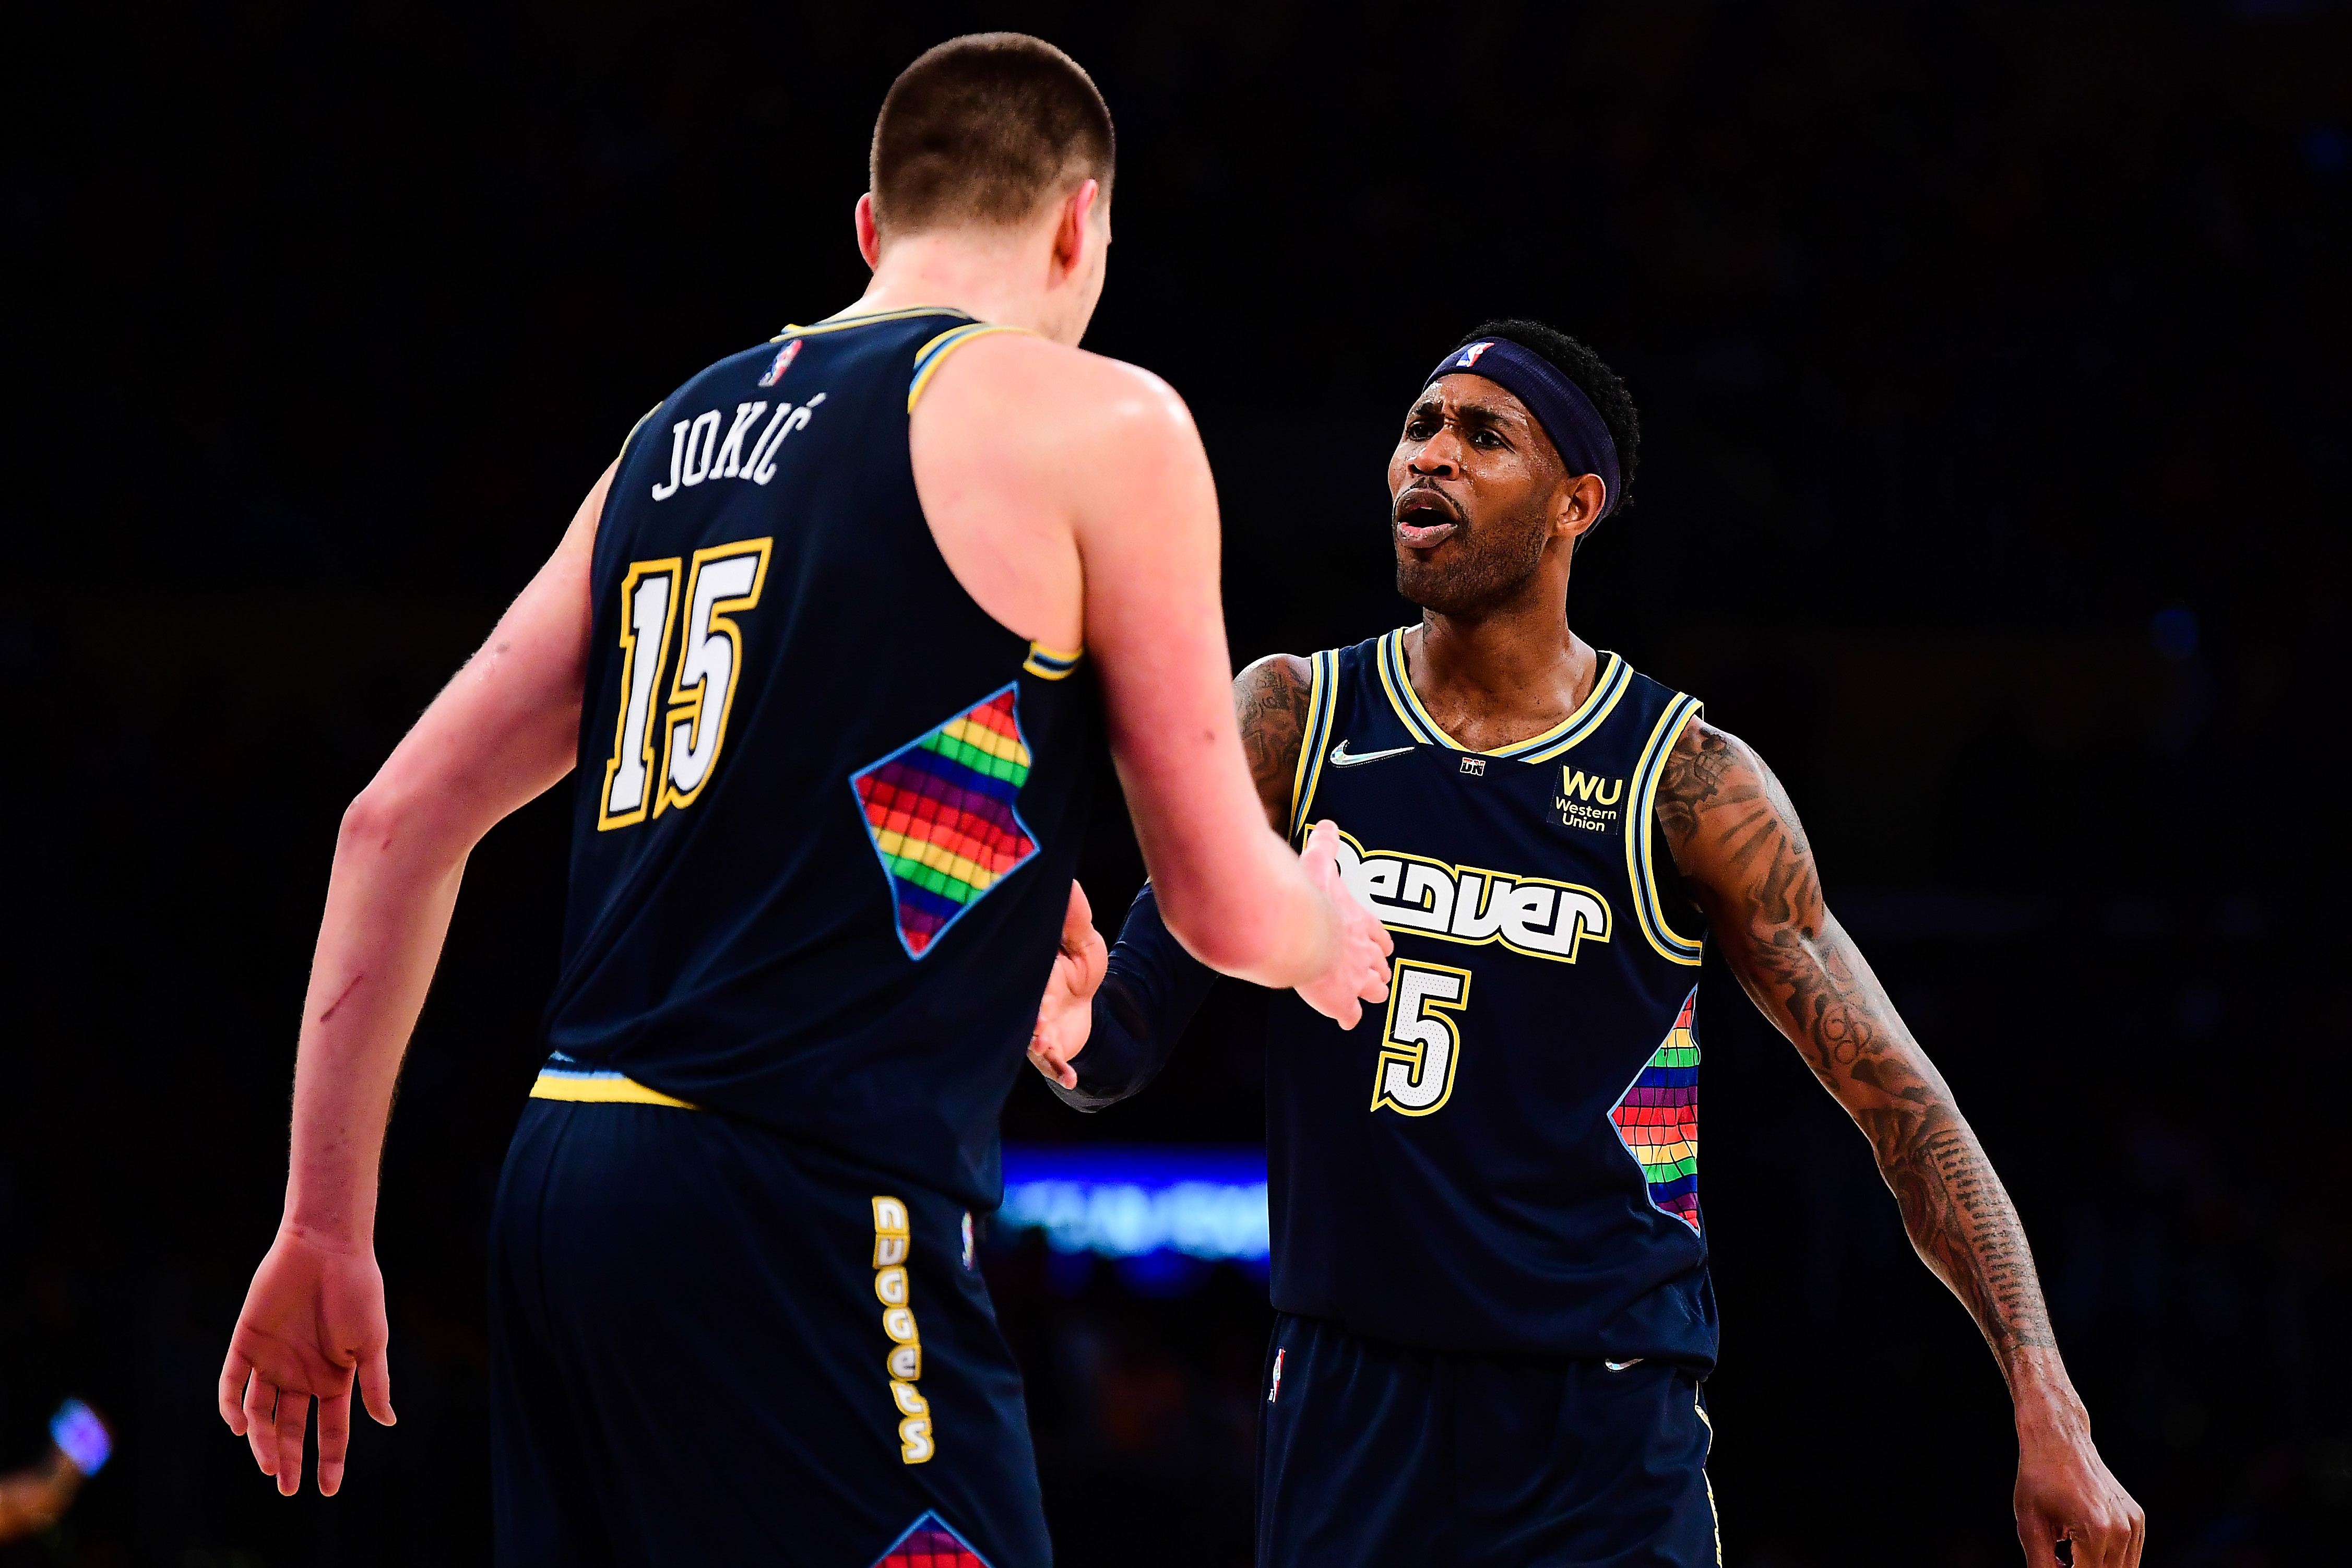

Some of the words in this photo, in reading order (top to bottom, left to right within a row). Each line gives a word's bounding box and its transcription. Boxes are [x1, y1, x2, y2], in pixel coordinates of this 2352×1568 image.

[652, 392, 827, 501] JOKIĆ
[597, 537, 774, 831] 15
[1556, 796, 1617, 819] Western
[1563, 765, 1623, 805] WU
[1563, 813, 1605, 831] Union
[1370, 957, 1471, 1117] 5
